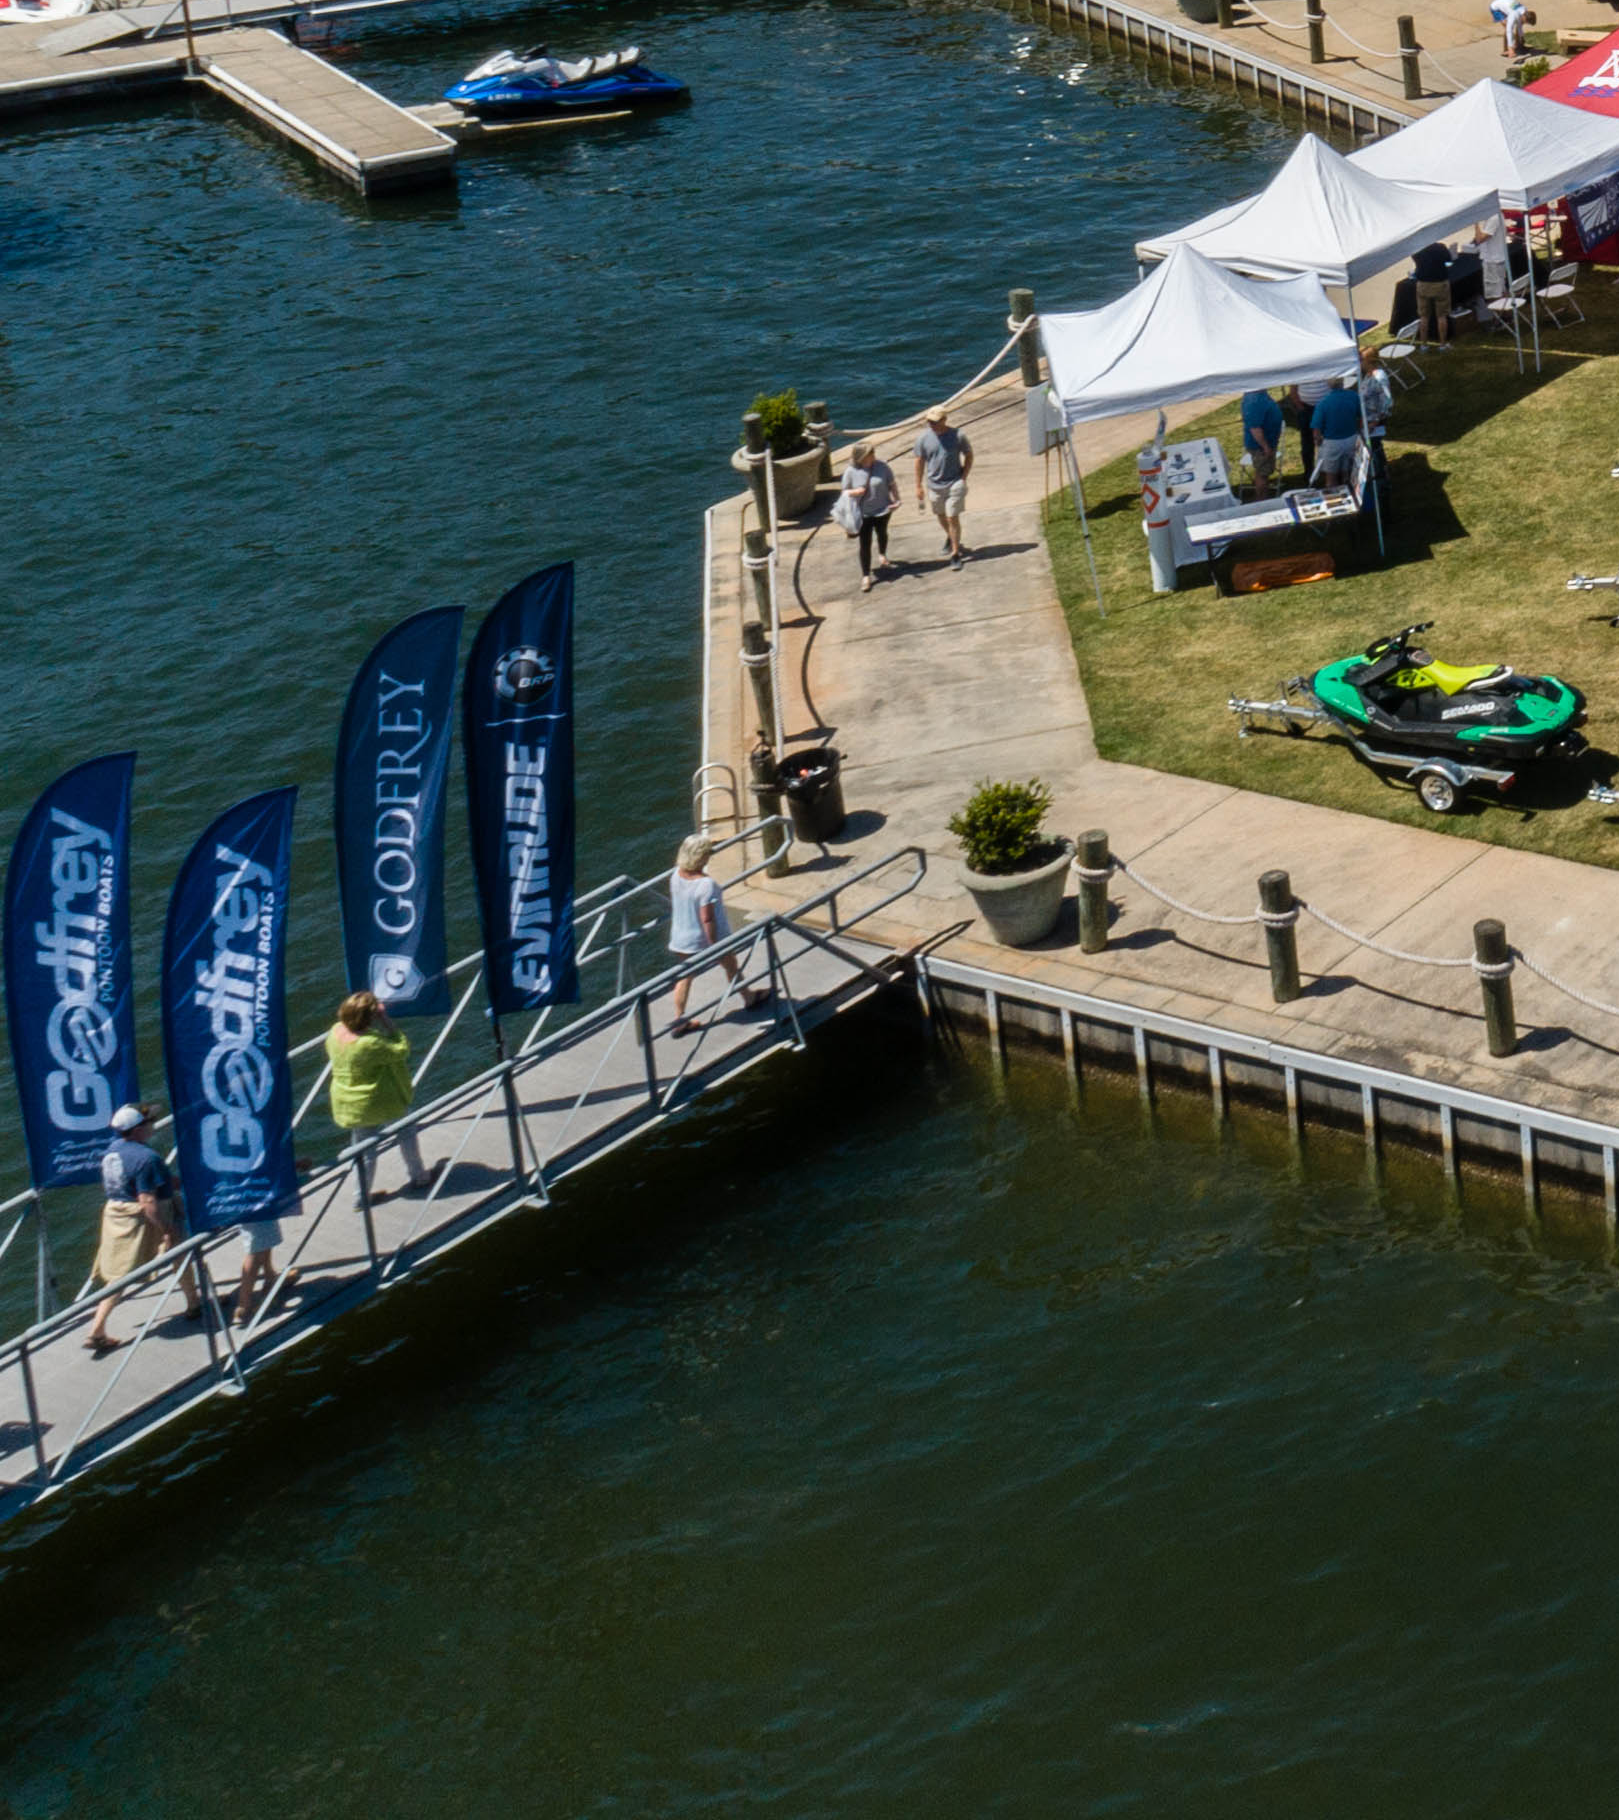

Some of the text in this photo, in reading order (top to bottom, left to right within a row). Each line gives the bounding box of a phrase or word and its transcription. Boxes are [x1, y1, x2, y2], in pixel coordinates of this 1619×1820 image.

[518, 673, 557, 691] BRP
[373, 669, 429, 937] GODFREY
[502, 740, 550, 995] EVINRUDE
[97, 853, 115, 1004] PONTOON BOATS
[254, 891, 275, 1048] PONTOON BOATS
